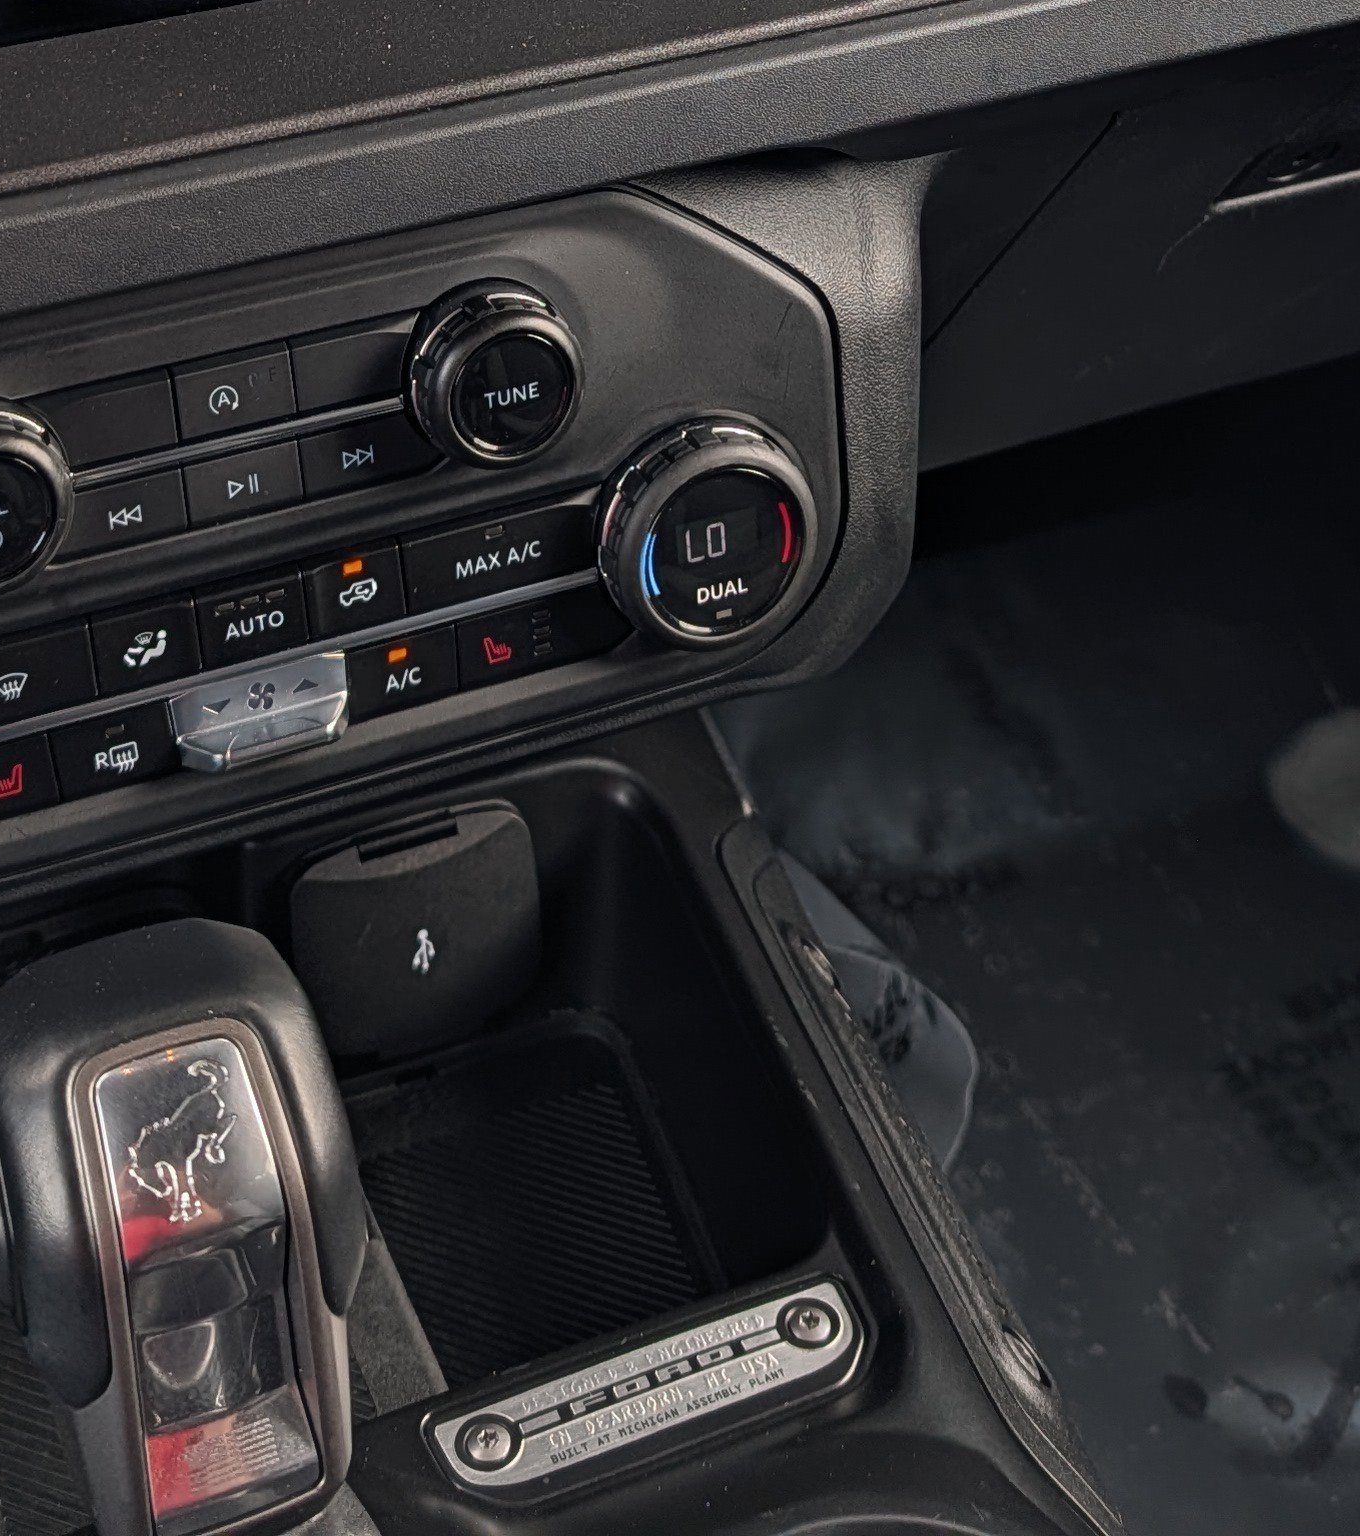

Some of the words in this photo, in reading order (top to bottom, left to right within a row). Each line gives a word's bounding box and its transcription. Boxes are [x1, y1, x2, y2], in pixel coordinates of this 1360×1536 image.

[483, 381, 541, 410] TUNE
[454, 553, 501, 580] MAX
[506, 540, 542, 566] A/C
[695, 576, 749, 605] DUAL
[223, 609, 285, 642] AUTO
[385, 666, 423, 694] A/C
[521, 1366, 619, 1413] DESIGNED
[644, 1314, 765, 1365] ENGINEERED
[569, 1344, 735, 1416] FORD
[548, 1428, 572, 1449] IN
[584, 1386, 694, 1436] DEARBORN,
[703, 1367, 733, 1390] MI
[740, 1351, 781, 1376] USA
[550, 1441, 590, 1465] BUILT
[596, 1433, 611, 1447] AT
[618, 1408, 681, 1437] MICHIGAN
[685, 1384, 742, 1411] ASSEMBLY
[748, 1368, 786, 1389] PLANT
